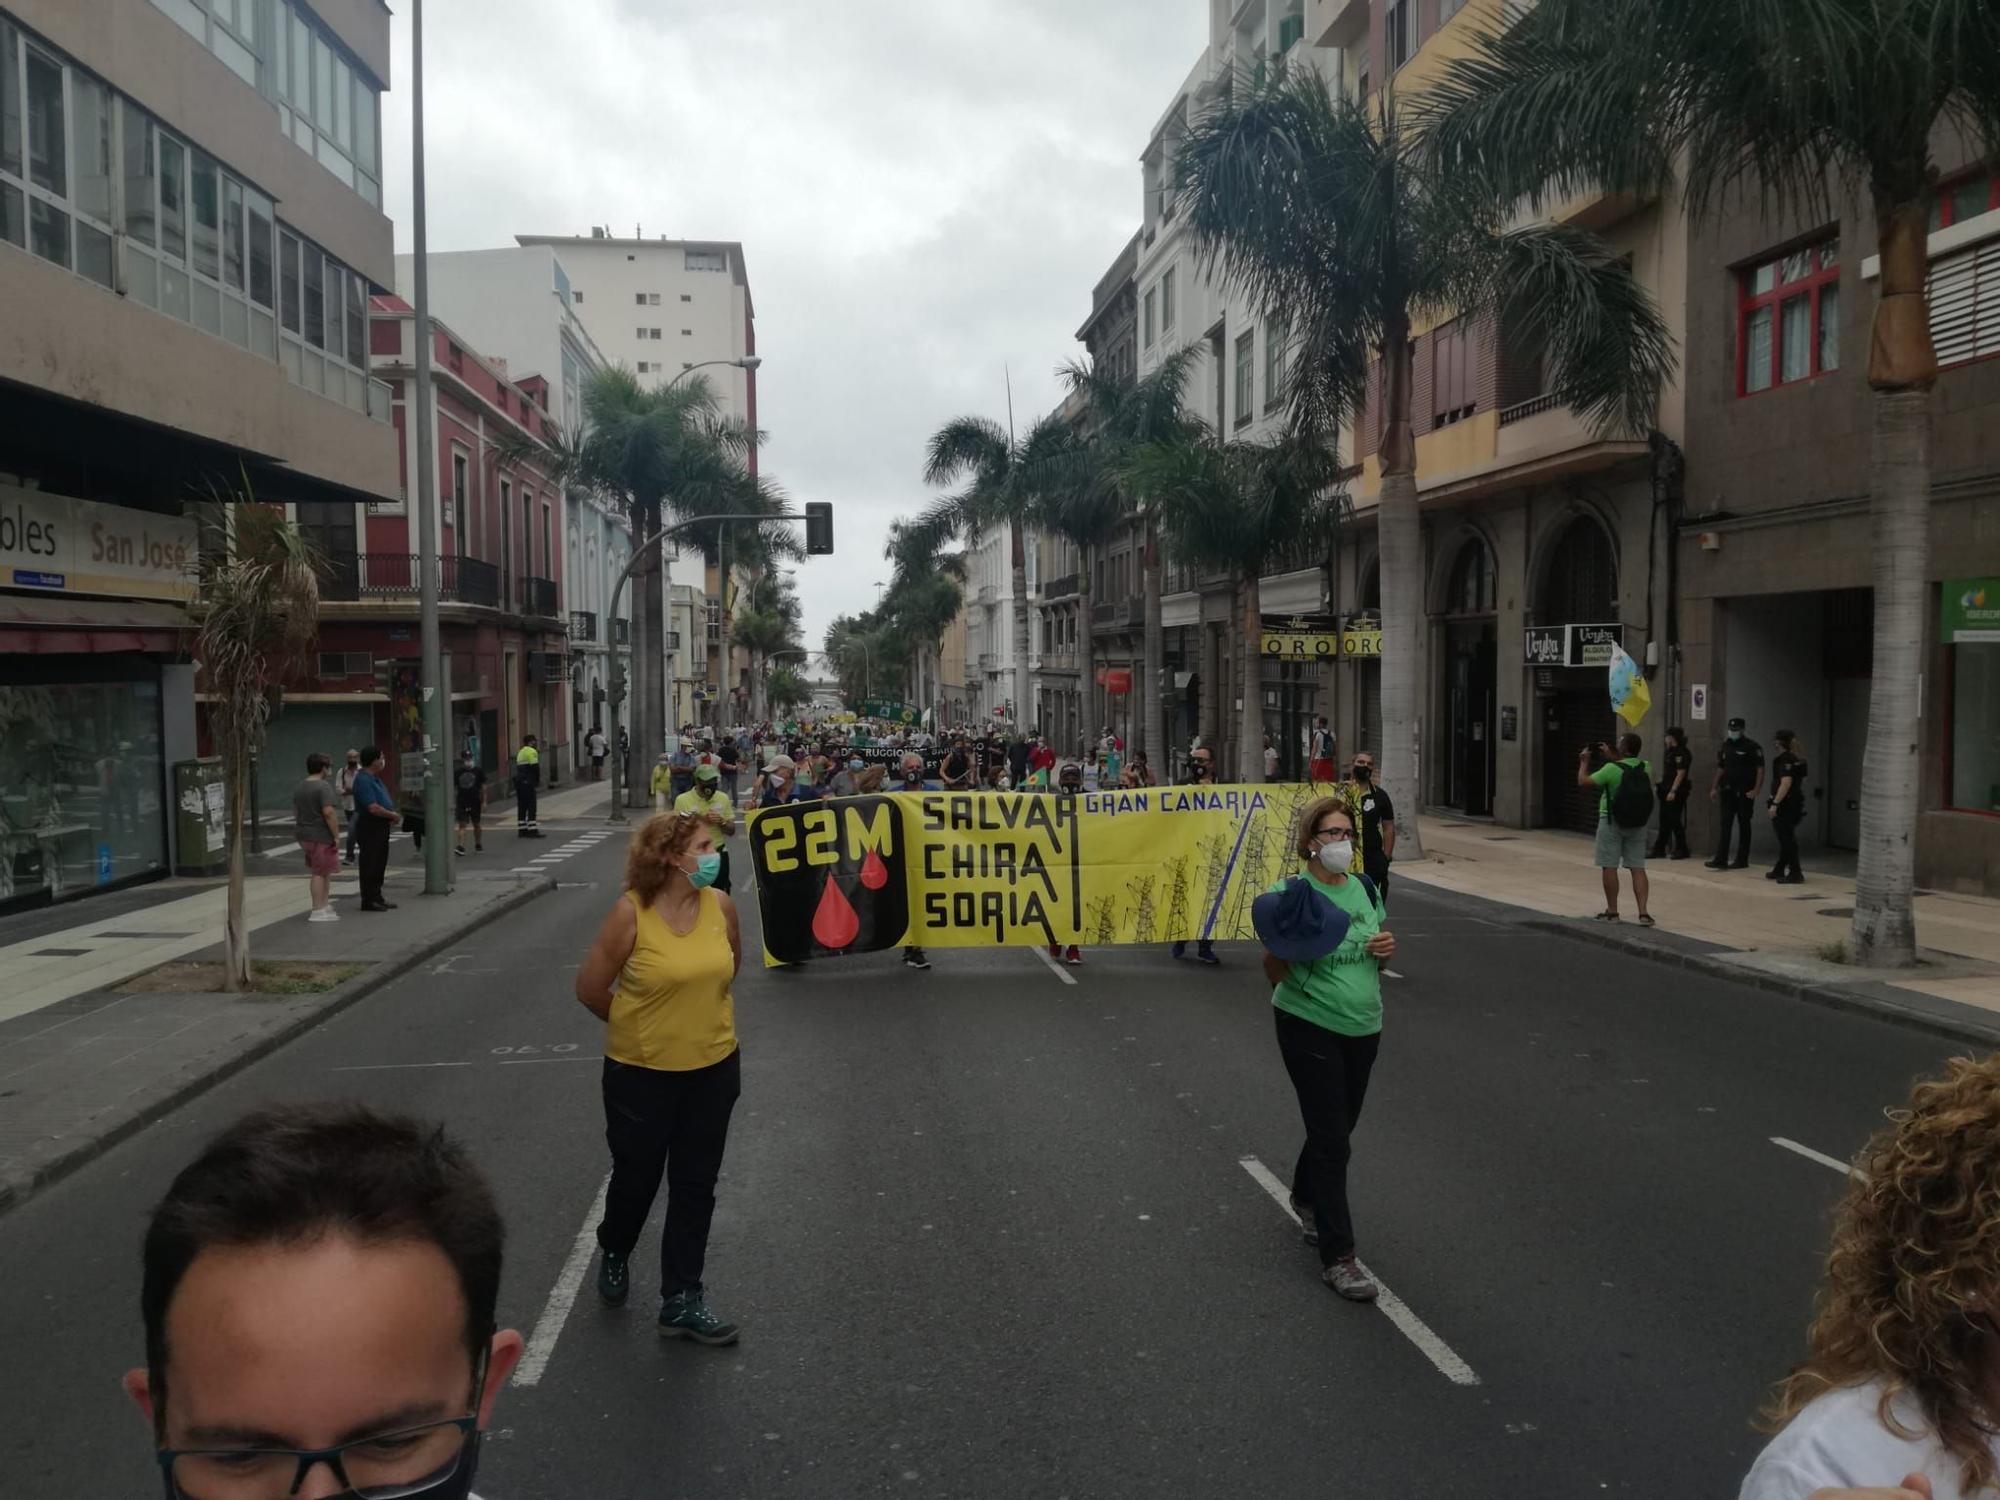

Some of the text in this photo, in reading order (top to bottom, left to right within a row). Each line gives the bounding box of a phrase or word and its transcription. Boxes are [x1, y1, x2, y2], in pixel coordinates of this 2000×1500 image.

[91, 521, 134, 565] San
[139, 530, 186, 572] José
[1267, 639, 1330, 654] ORO
[1085, 793, 1147, 816] GRAN
[760, 803, 893, 873] 22M
[924, 843, 1058, 902] CHIRA
[925, 891, 1056, 944] SORIA
